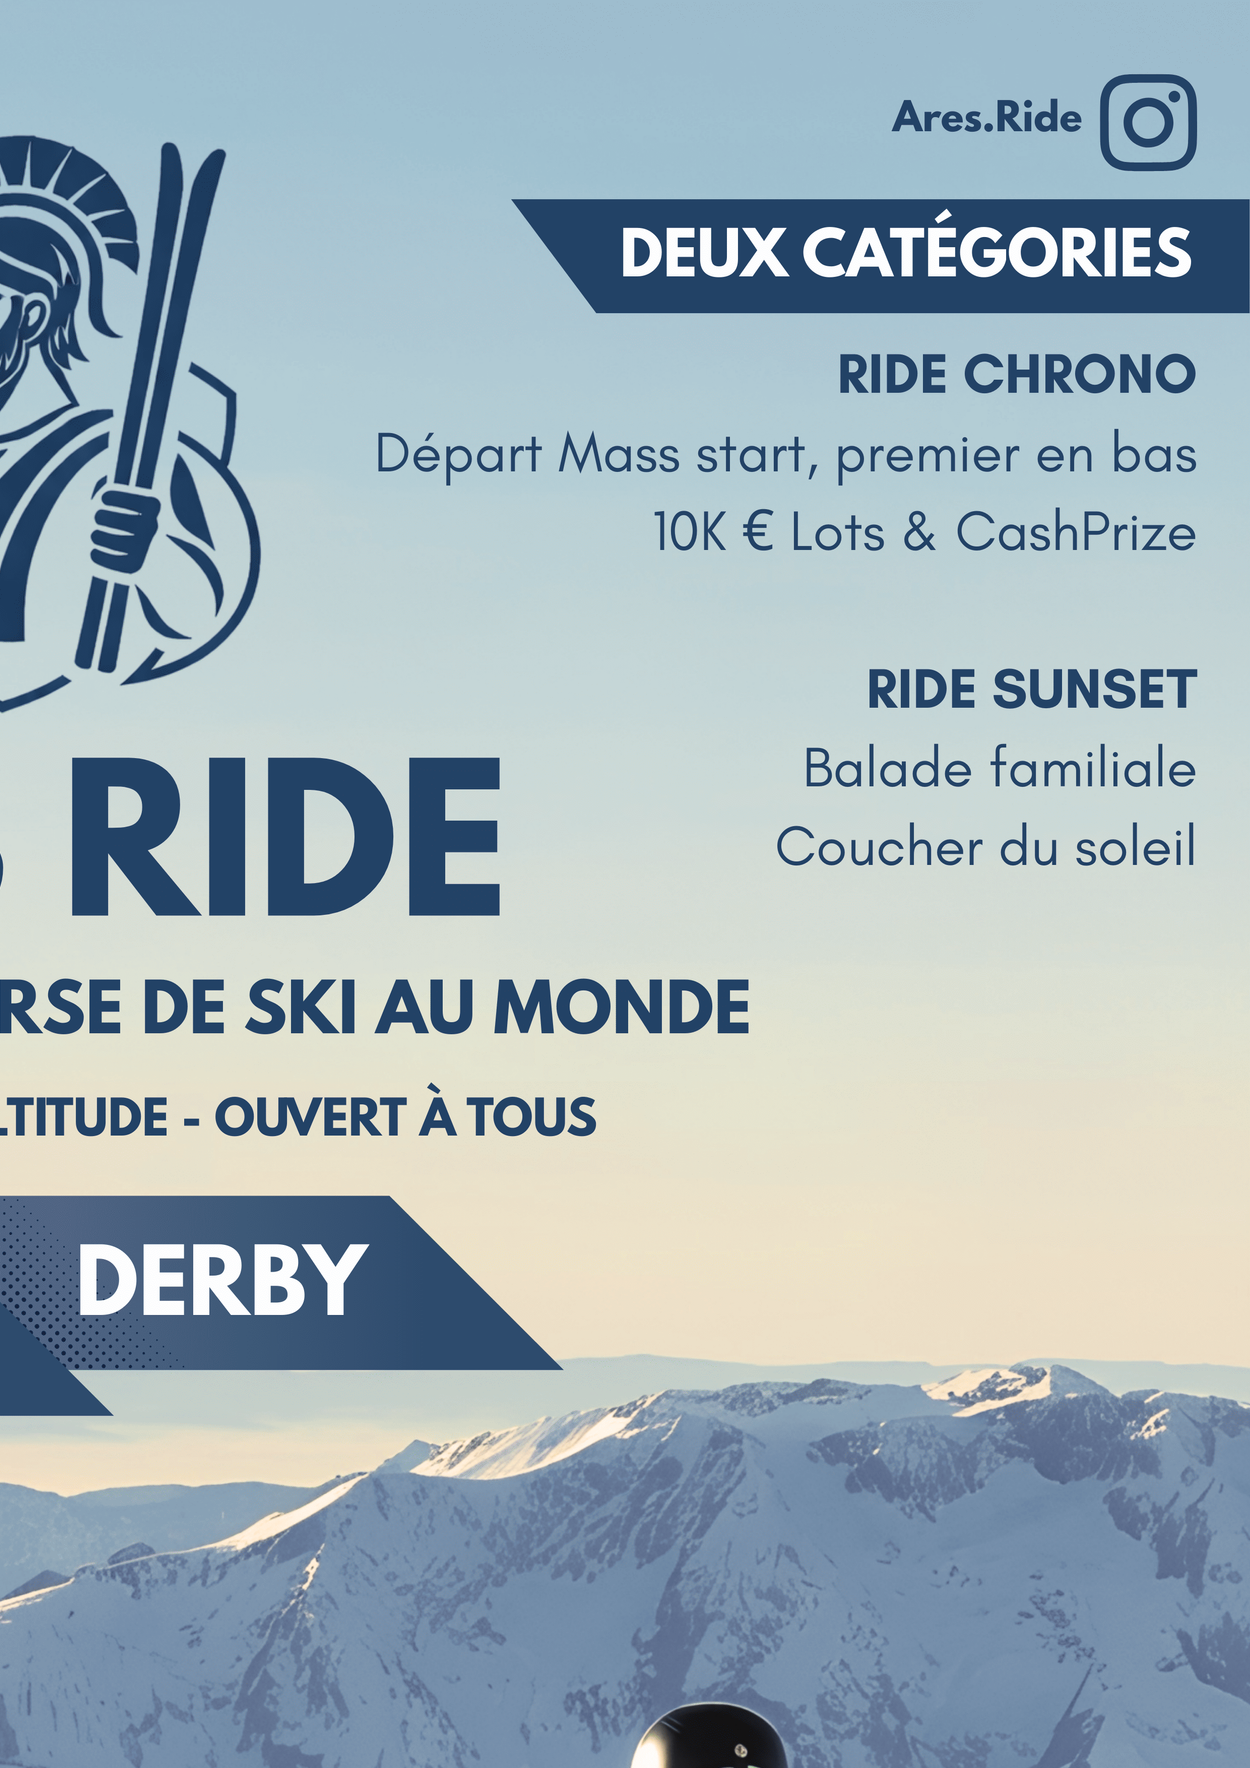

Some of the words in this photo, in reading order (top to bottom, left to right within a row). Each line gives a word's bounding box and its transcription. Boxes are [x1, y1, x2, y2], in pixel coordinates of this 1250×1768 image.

[892, 99, 1081, 132] Ares.Ride
[623, 228, 789, 277] DEUX
[803, 209, 1191, 277] CATÉGORIES
[840, 354, 945, 393] RIDE
[965, 354, 1196, 393] CHRONO
[378, 433, 542, 486] Départ
[559, 431, 679, 473] Mass
[697, 437, 817, 479] start,
[838, 437, 1019, 486] premier
[1038, 446, 1091, 472] en
[1114, 429, 1196, 472] bas
[655, 511, 726, 551] 10K
[743, 509, 773, 551] €
[794, 511, 884, 551] Lots
[904, 511, 936, 551] &
[958, 507, 1195, 551] CashPrize
[869, 669, 975, 708] RIDE
[994, 669, 1197, 709] SUNSET
[807, 744, 971, 787] Balade
[990, 744, 1195, 787] familiale
[71, 758, 500, 916] RIDE
[777, 822, 983, 866] Coucher
[1001, 822, 1056, 866] du
[1076, 822, 1193, 866] soleil
[145, 979, 224, 1033] DE
[245, 979, 355, 1034] SKI
[375, 979, 473, 1034] AU
[494, 978, 749, 1034] MONDE
[215, 1097, 407, 1136] OUVERT
[419, 1083, 457, 1136] À
[467, 1097, 596, 1136] TOUS
[80, 1244, 369, 1315] DERBY
